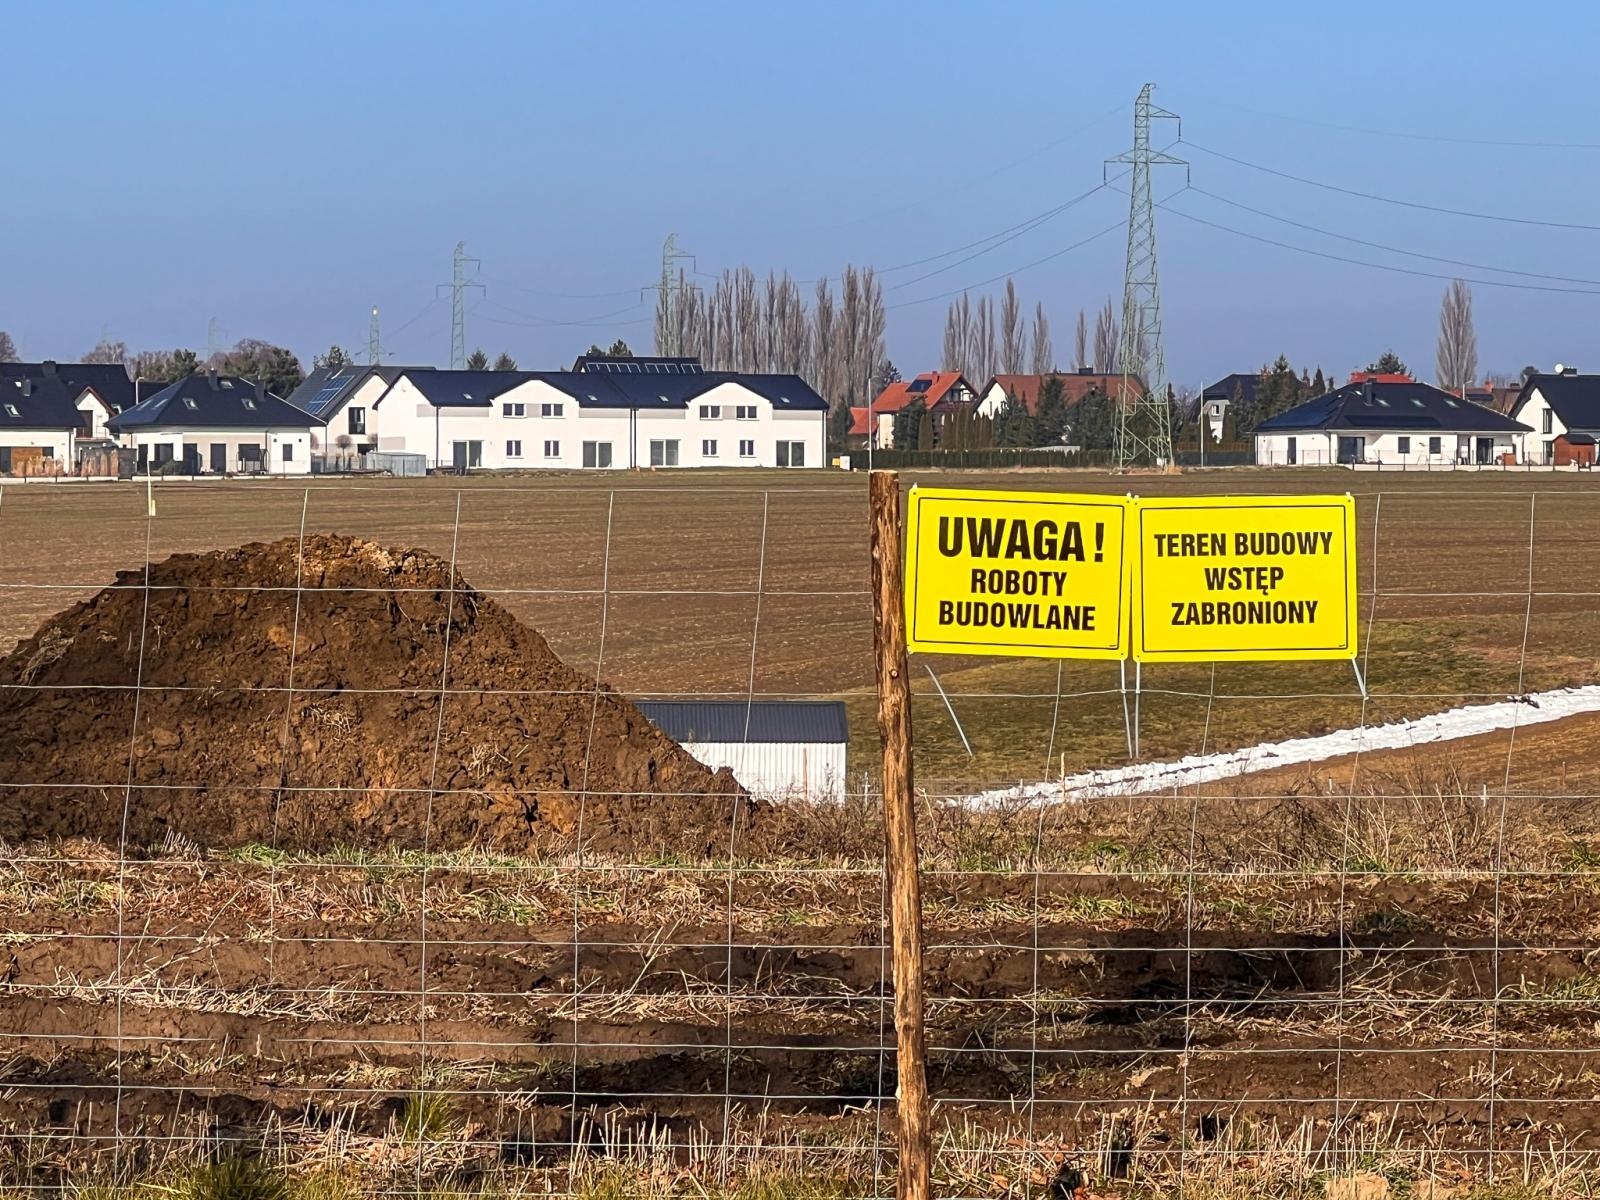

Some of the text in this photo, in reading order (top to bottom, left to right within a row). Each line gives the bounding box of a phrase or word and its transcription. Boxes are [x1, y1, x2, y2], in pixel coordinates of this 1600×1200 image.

[1153, 530, 1334, 558] TEREN BUDOWY
[970, 568, 1068, 598] ROBOTY
[1203, 566, 1285, 597] WSTĘP
[938, 600, 1097, 632] BUDOWLANE
[1170, 599, 1319, 627] ZABRONIONY
